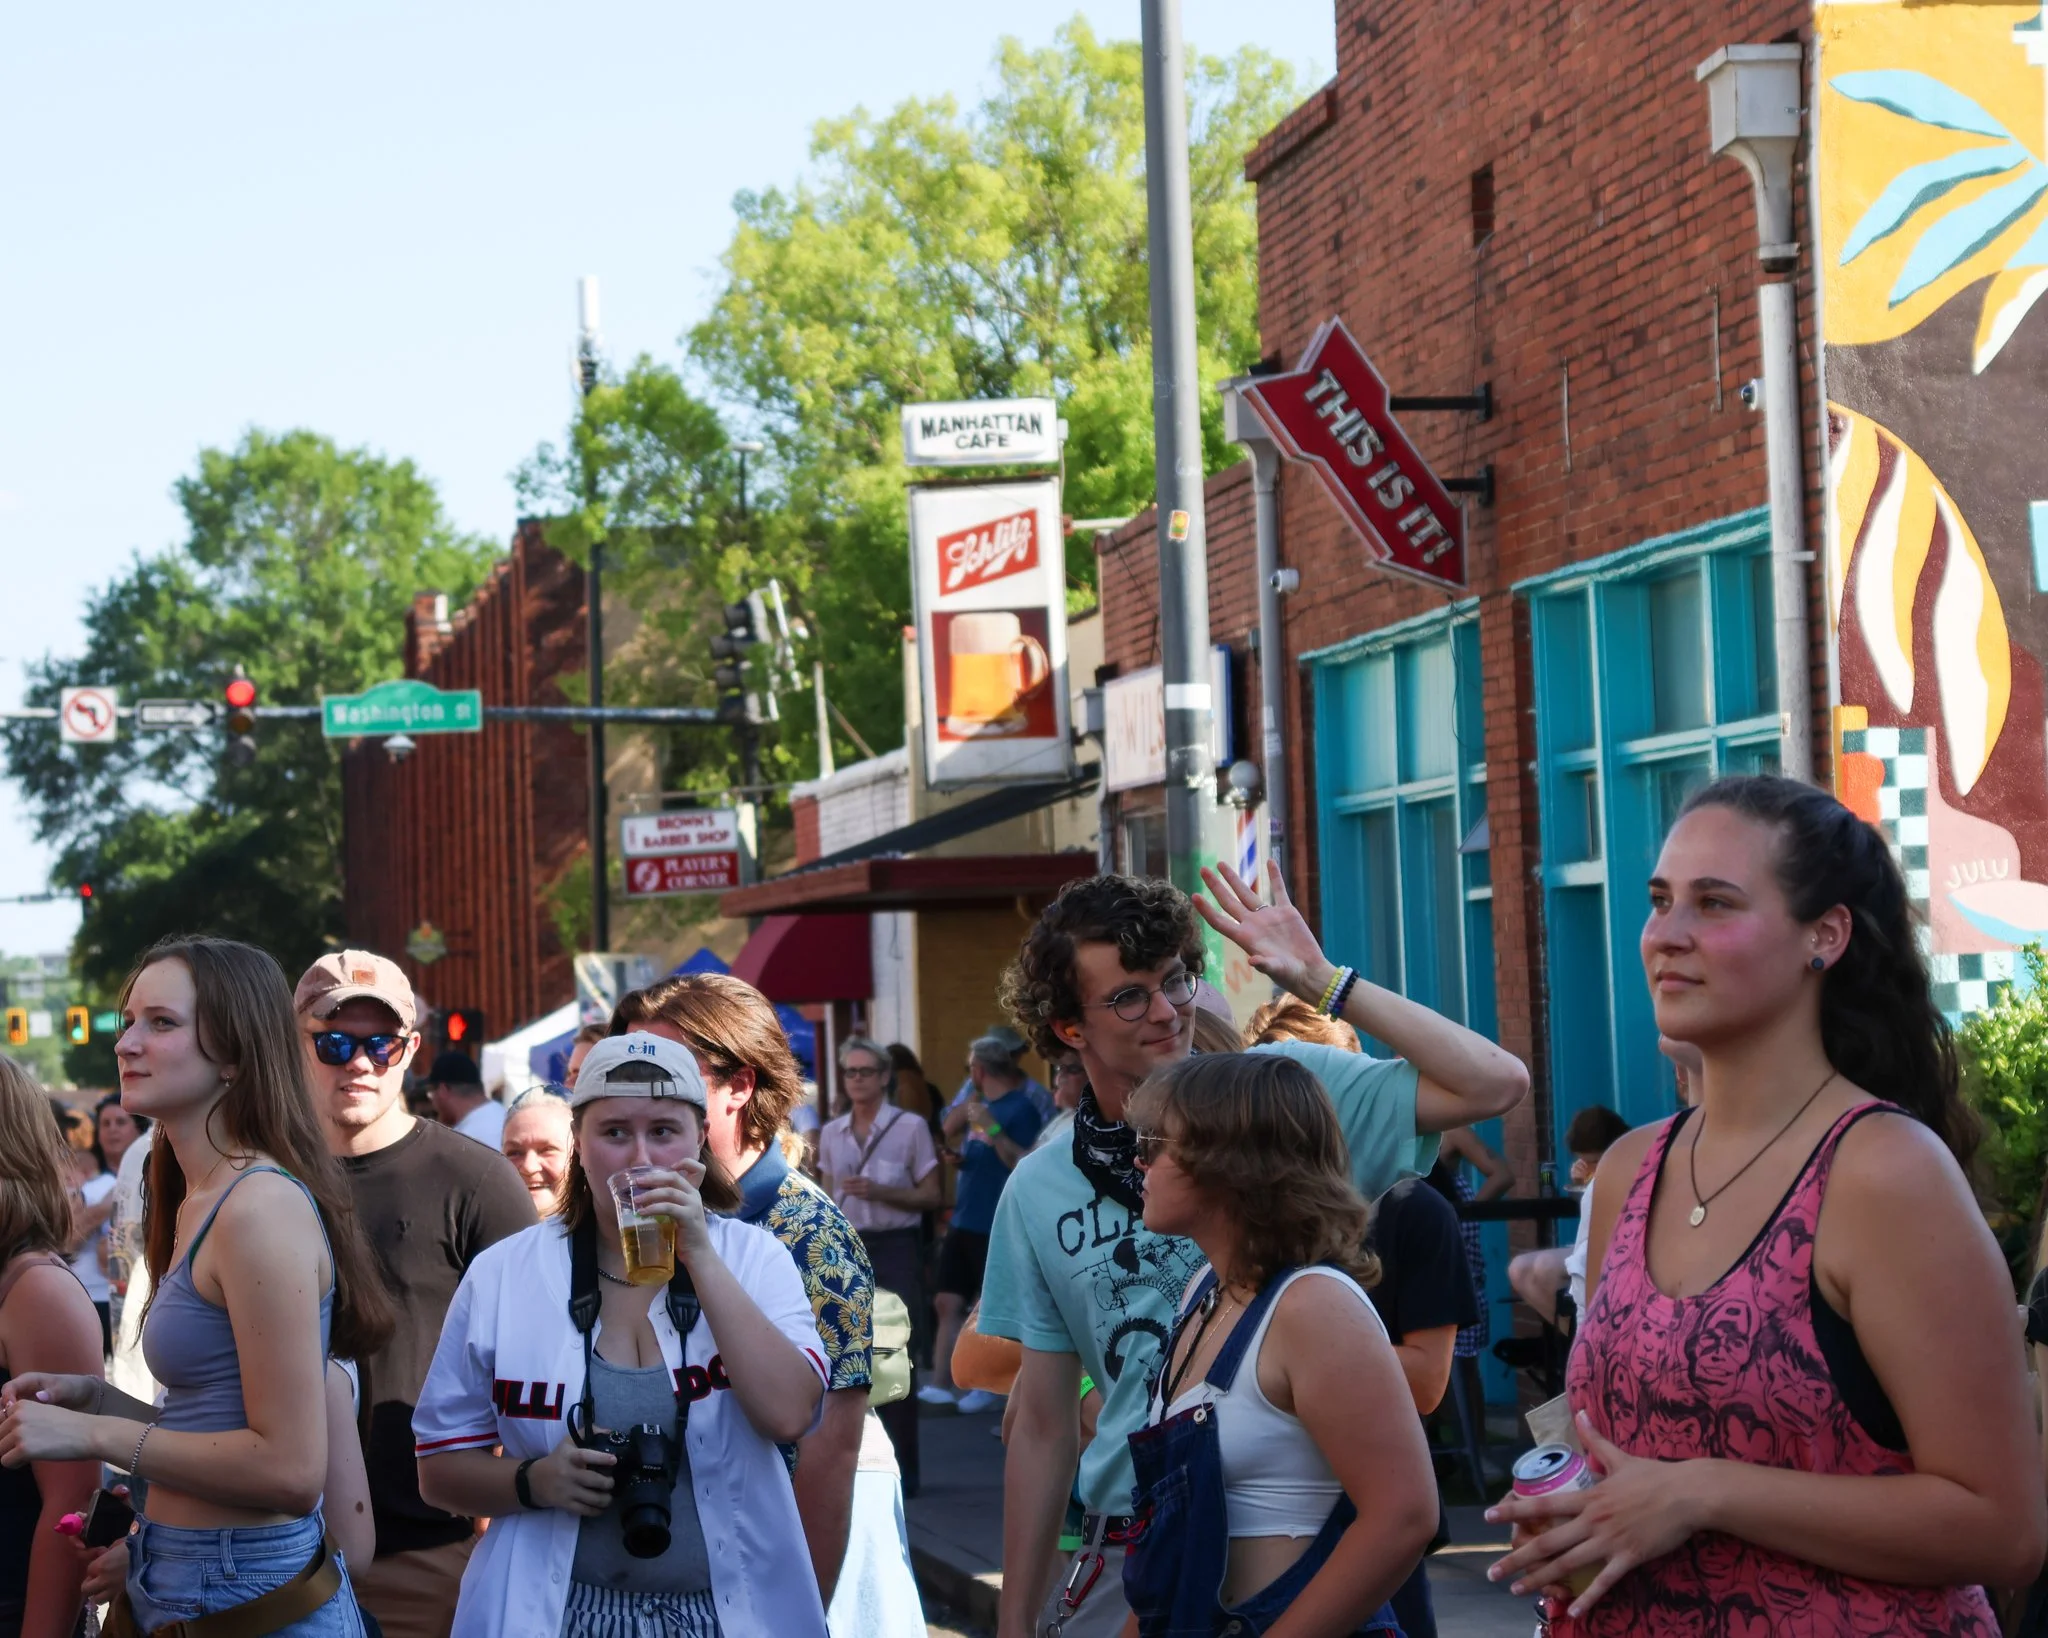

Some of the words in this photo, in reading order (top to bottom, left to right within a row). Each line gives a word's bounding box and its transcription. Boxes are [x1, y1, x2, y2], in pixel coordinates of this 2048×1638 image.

[920, 412, 1043, 440] MANHATTAN
[955, 432, 1011, 449] CAFE
[1304, 367, 1385, 467] THIS
[1367, 461, 1415, 509] IS
[1398, 503, 1455, 564] IT!
[945, 516, 1033, 588] Schlitz
[332, 703, 444, 727] Washington
[643, 833, 690, 848] BARBER
[696, 830, 729, 844] SHOP
[1946, 858, 2009, 889] JULU
